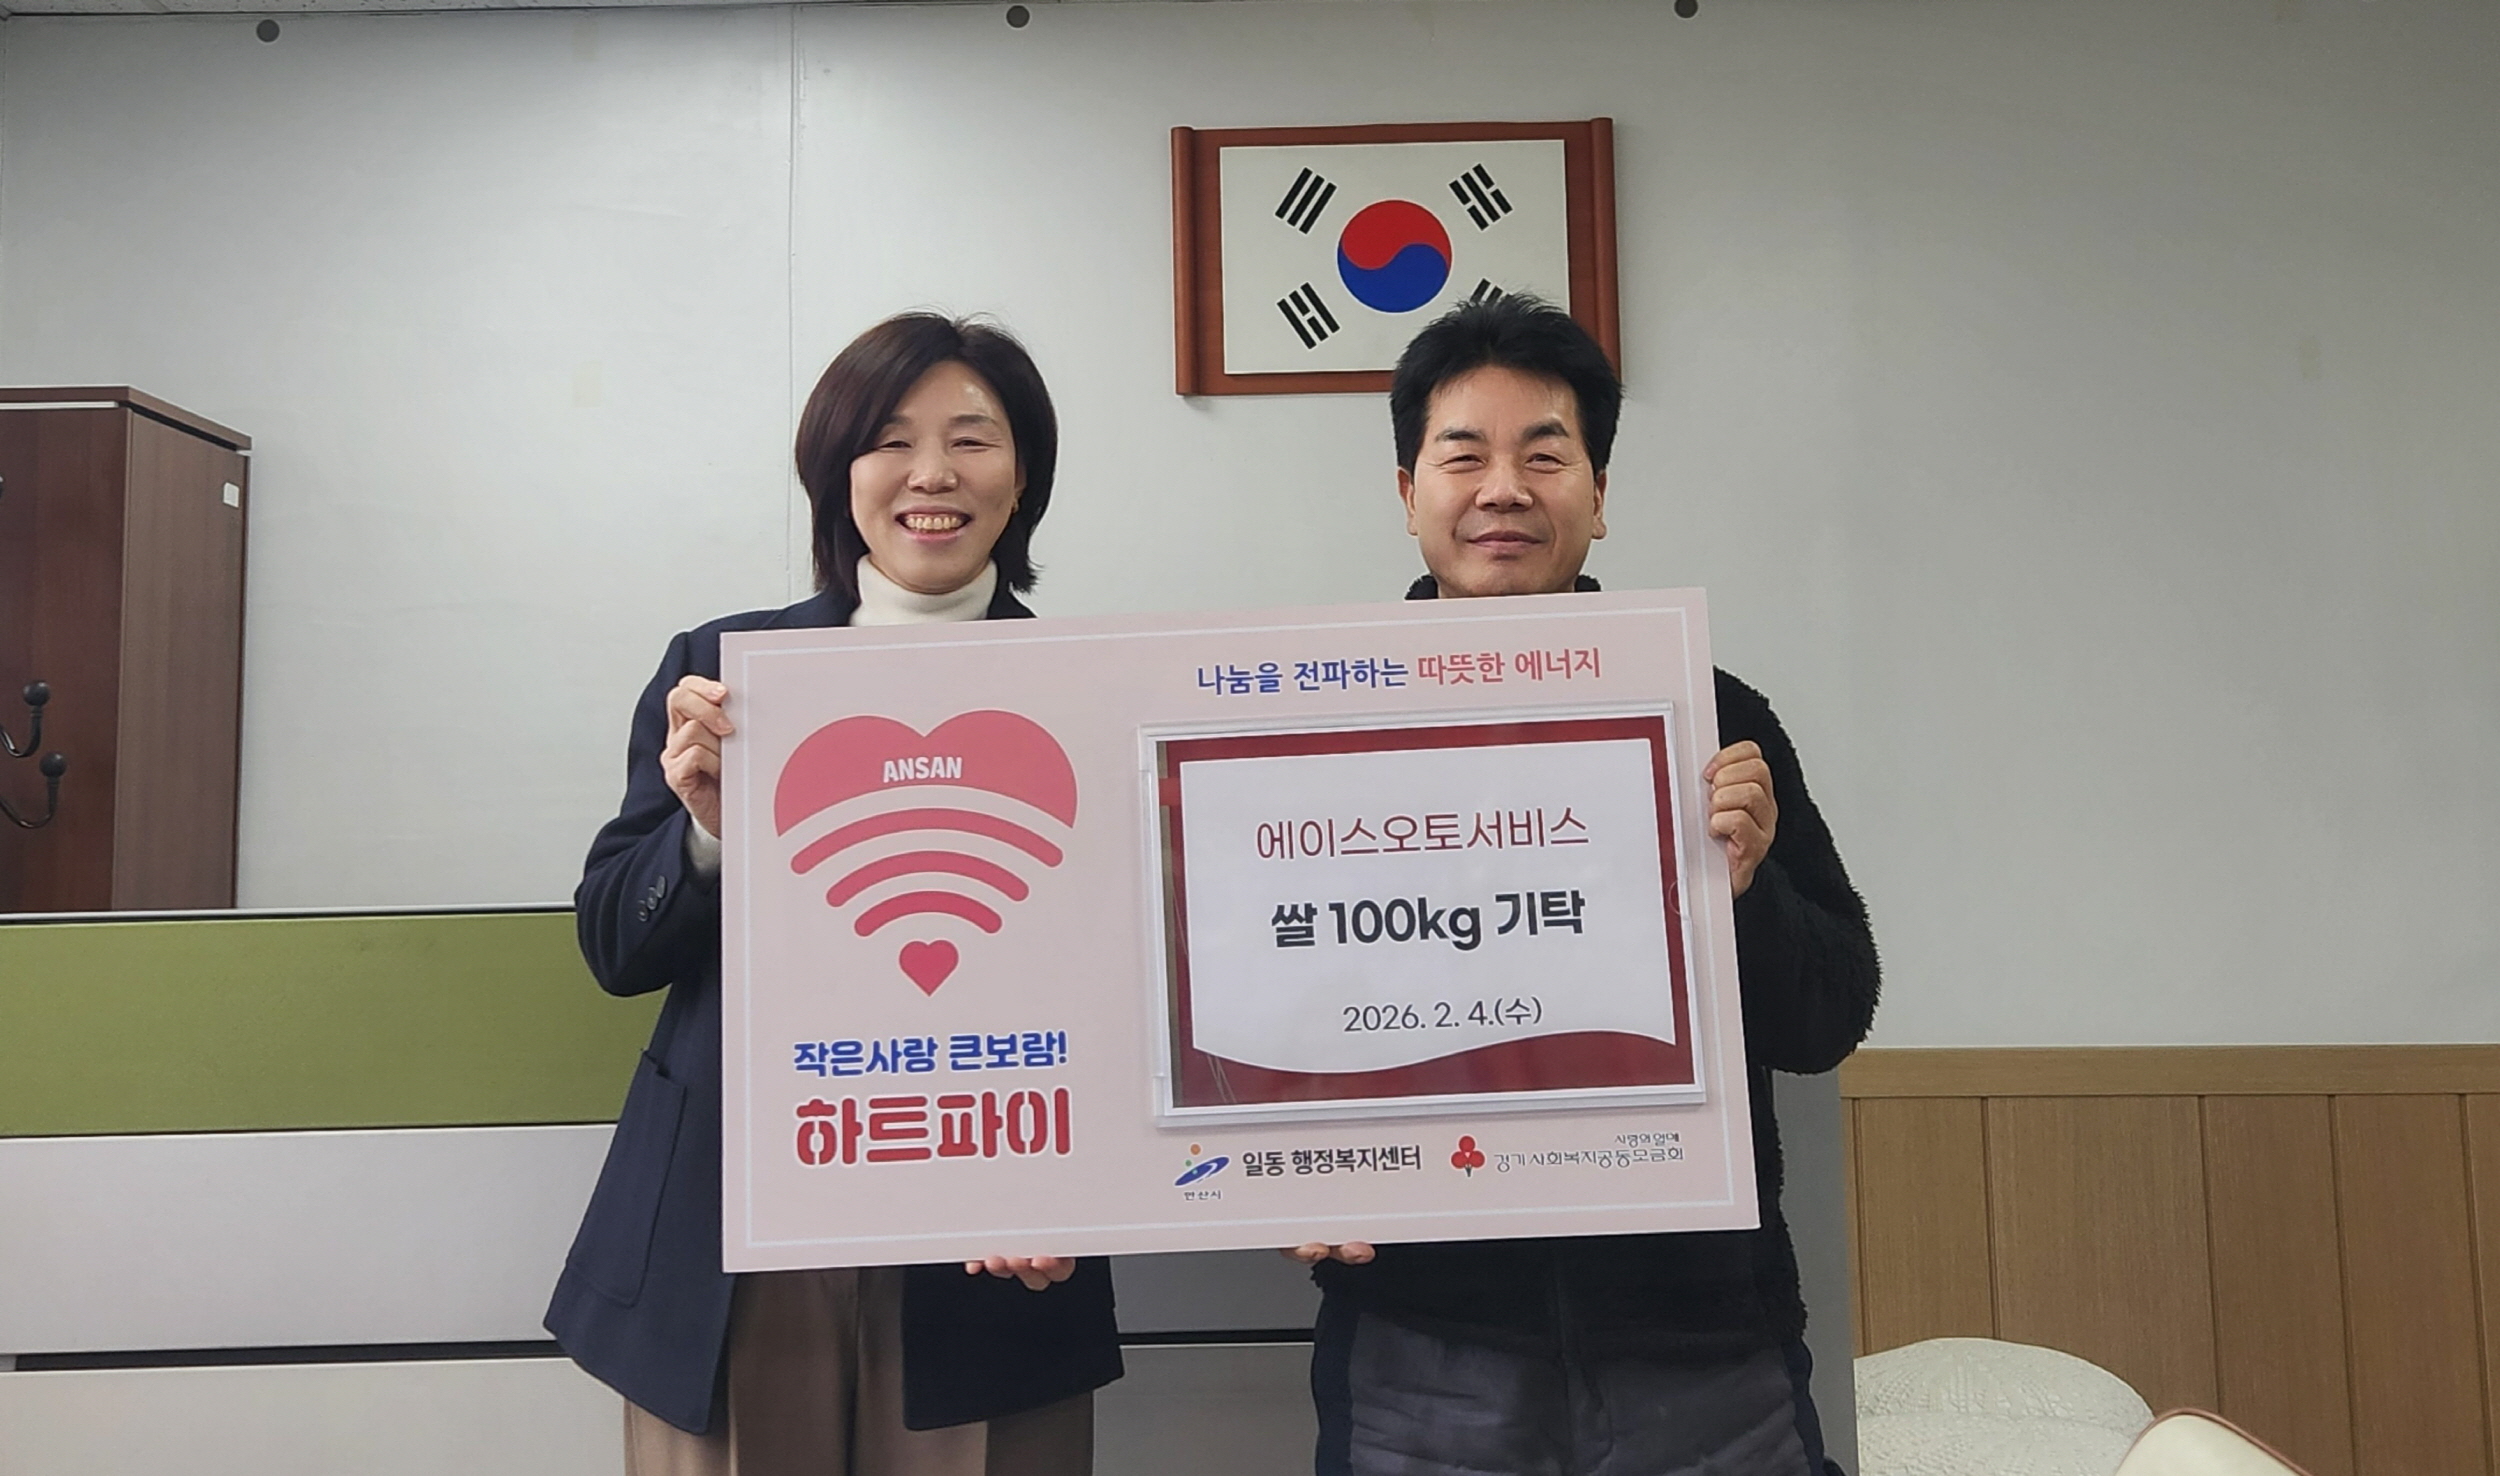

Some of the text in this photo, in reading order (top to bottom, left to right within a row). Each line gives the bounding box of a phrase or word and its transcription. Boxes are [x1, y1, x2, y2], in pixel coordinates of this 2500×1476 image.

[1198, 647, 1602, 695] 나눔을 전파하는 따뜻한 에너지
[883, 756, 963, 784] ANSAN
[1256, 806, 1590, 860] 에이스오토서비스
[1271, 890, 1586, 951] 쌀 100kg 기탁
[1342, 996, 1543, 1033] 2026. 2. 4.(수)
[793, 1031, 1068, 1077] 작은사랑 큰보람!
[795, 1087, 1072, 1166] 하트파이
[1242, 1145, 1422, 1177] 일동 행정복지센터
